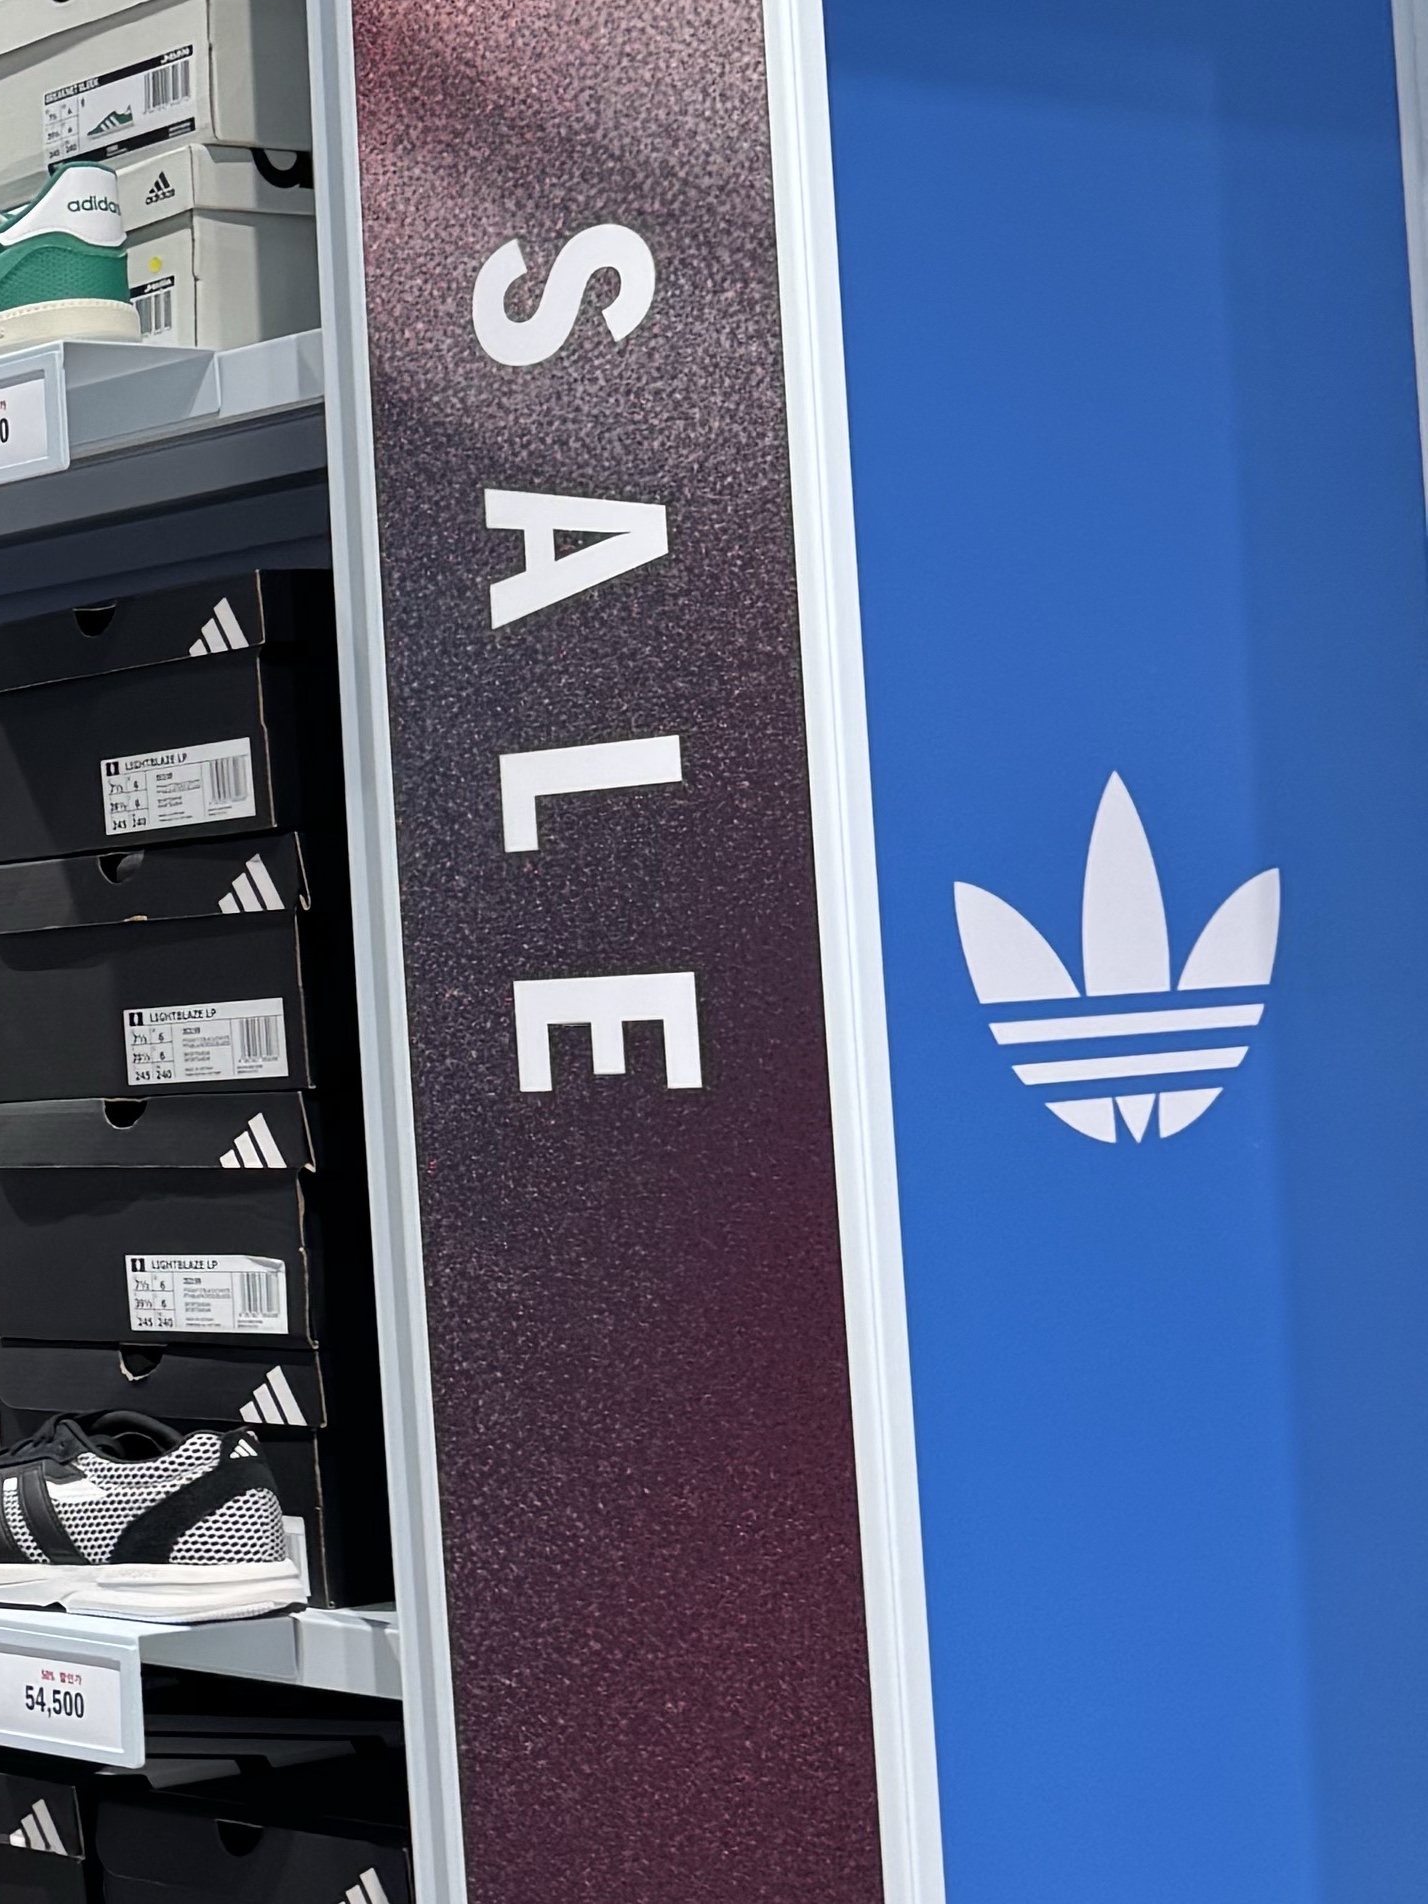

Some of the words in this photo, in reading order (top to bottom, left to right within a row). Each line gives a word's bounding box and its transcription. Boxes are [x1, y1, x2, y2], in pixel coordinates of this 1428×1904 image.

[471, 222, 703, 1093] SALE
[150, 1009, 204, 1023] LIGHTBLAZE
[151, 1258, 205, 1270] LIGHTBLAZE
[207, 1259, 219, 1270] LP
[25, 1685, 85, 1719] 54,500
